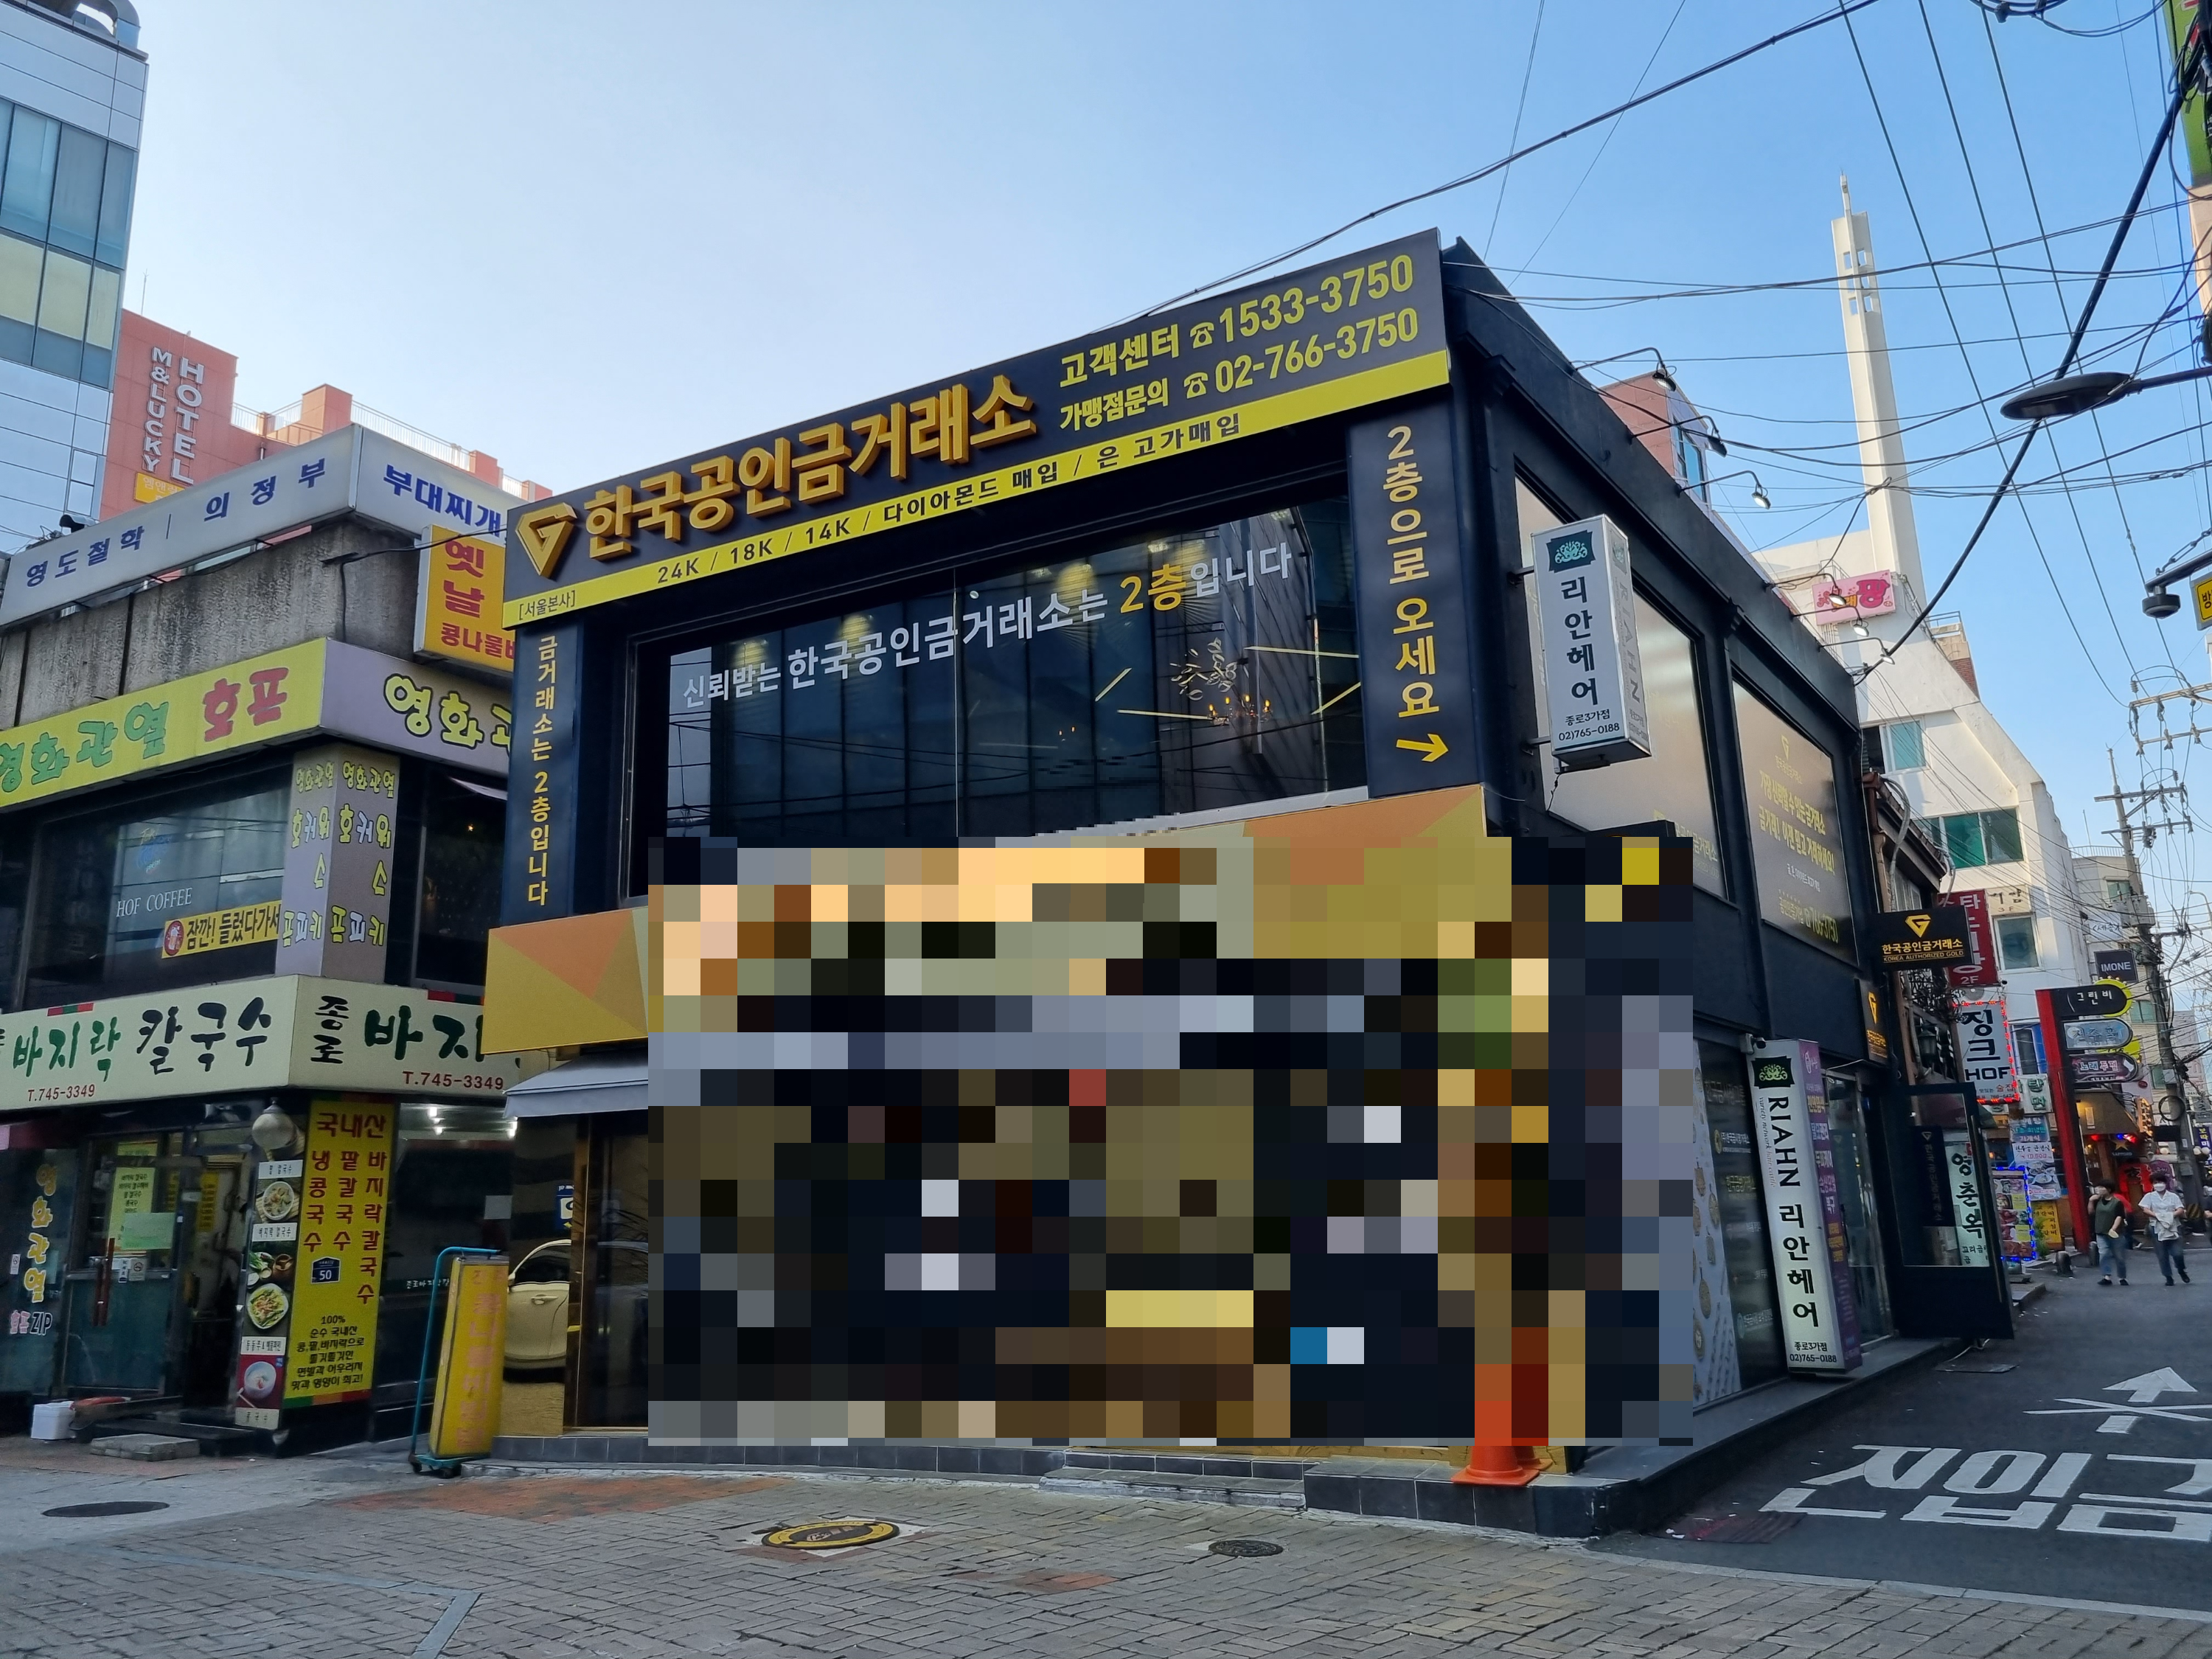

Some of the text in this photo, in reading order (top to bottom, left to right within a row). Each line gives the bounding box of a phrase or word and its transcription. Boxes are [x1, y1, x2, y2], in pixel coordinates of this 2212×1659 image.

[1060, 254, 1413, 387] 고객센터 1533-3750
[1060, 307, 1419, 431] 가맹점문의 02-766-3750
[170, 357, 204, 485] HOTEL
[583, 374, 1037, 562] 한국공인금거래소
[383, 465, 501, 538] 부대찌개
[657, 412, 1240, 584] 24K 18K 14K 다이아몬드 매입 은 고가매입
[27, 458, 324, 587] 영도철학 의정부
[443, 540, 485, 618] 옛날
[1383, 425, 1440, 718] 2층으로 오세요
[519, 590, 576, 621] [서울본사]
[684, 542, 1293, 709] 신뢰받는 한국공인금거래소는 2층입니다
[1560, 576, 1599, 706] 리안헤어
[203, 667, 289, 742] 호프
[1565, 709, 1610, 726] 종로3가점
[1558, 723, 1620, 742] 02)765-0188
[527, 636, 558, 906] 금거래소는 2층입니다
[116, 887, 193, 918] HOF COFFEE
[187, 916, 217, 950] 잠깐!
[1882, 939, 1964, 955] 한국공인금거래소
[1960, 975, 1979, 984] 2F
[2100, 961, 2132, 972] IMONE
[2076, 990, 2112, 1005] 그린비
[13, 996, 273, 1082] 바지락 칼국수
[310, 995, 349, 1064] 종로
[1961, 1009, 2001, 1062] 징크
[403, 1071, 504, 1090] T.745-3349
[1964, 1066, 2011, 1082] HOF
[27, 1084, 95, 1102] T.745-3349
[316, 1112, 386, 1138] 국내산
[1767, 1096, 1801, 1189] RIAHN
[319, 1270, 333, 1281] 50
[1778, 1204, 1819, 1328] 리안헤어
[29, 1311, 54, 1336] ZIP
[310, 1325, 358, 1339] 순수 국내산
[321, 1315, 346, 1325] 100%
[1789, 1352, 1837, 1364] 02)765-0188
[1793, 1340, 1828, 1353] 종로3가점
